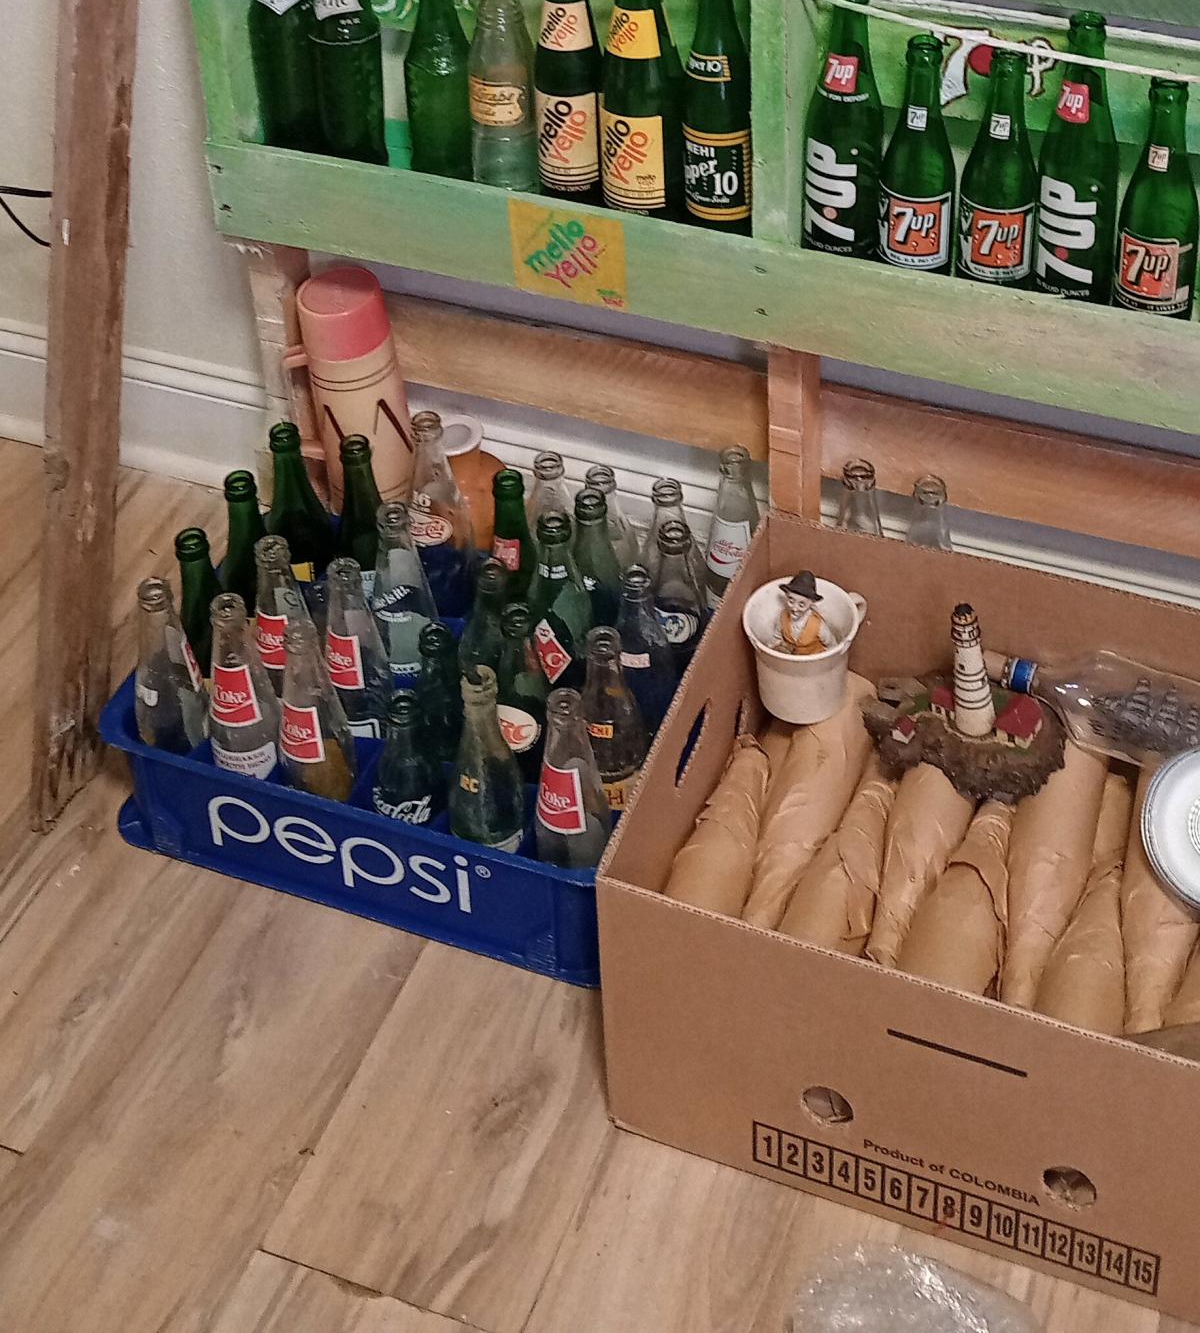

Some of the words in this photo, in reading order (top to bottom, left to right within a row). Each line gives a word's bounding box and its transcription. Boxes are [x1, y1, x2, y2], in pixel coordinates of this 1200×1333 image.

[539, 6, 567, 45] mello
[705, 60, 722, 73] 10
[539, 99, 573, 159] mello
[685, 159, 718, 185] pper
[712, 170, 739, 197] 10
[893, 206, 935, 243] 7up
[977, 219, 1020, 256] 7up
[524, 220, 585, 274] mello
[1125, 244, 1170, 284] 7up
[257, 626, 284, 646] Coke
[213, 684, 247, 704] Coke
[281, 715, 312, 739] Coke
[459, 773, 480, 794] RC
[540, 781, 571, 809] Coke
[863, 1137, 925, 1167] Product
[929, 1162, 945, 1175] of
[949, 1168, 1041, 1207] COLOMBIA
[763, 1135, 772, 1158] 1
[786, 1142, 800, 1166] 2
[811, 1150, 825, 1175] 3
[837, 1159, 851, 1184] 4
[863, 1167, 877, 1192] 5
[889, 1176, 903, 1201] 6
[916, 1184, 930, 1210] 7
[942, 1194, 956, 1220] 8
[969, 1204, 983, 1228] 9
[993, 1211, 1014, 1239] 10
[1022, 1221, 1040, 1248] 11
[1048, 1229, 1069, 1257] 12
[1076, 1239, 1097, 1266] 13
[1104, 1248, 1125, 1276] 14
[1132, 1259, 1154, 1285] 15
